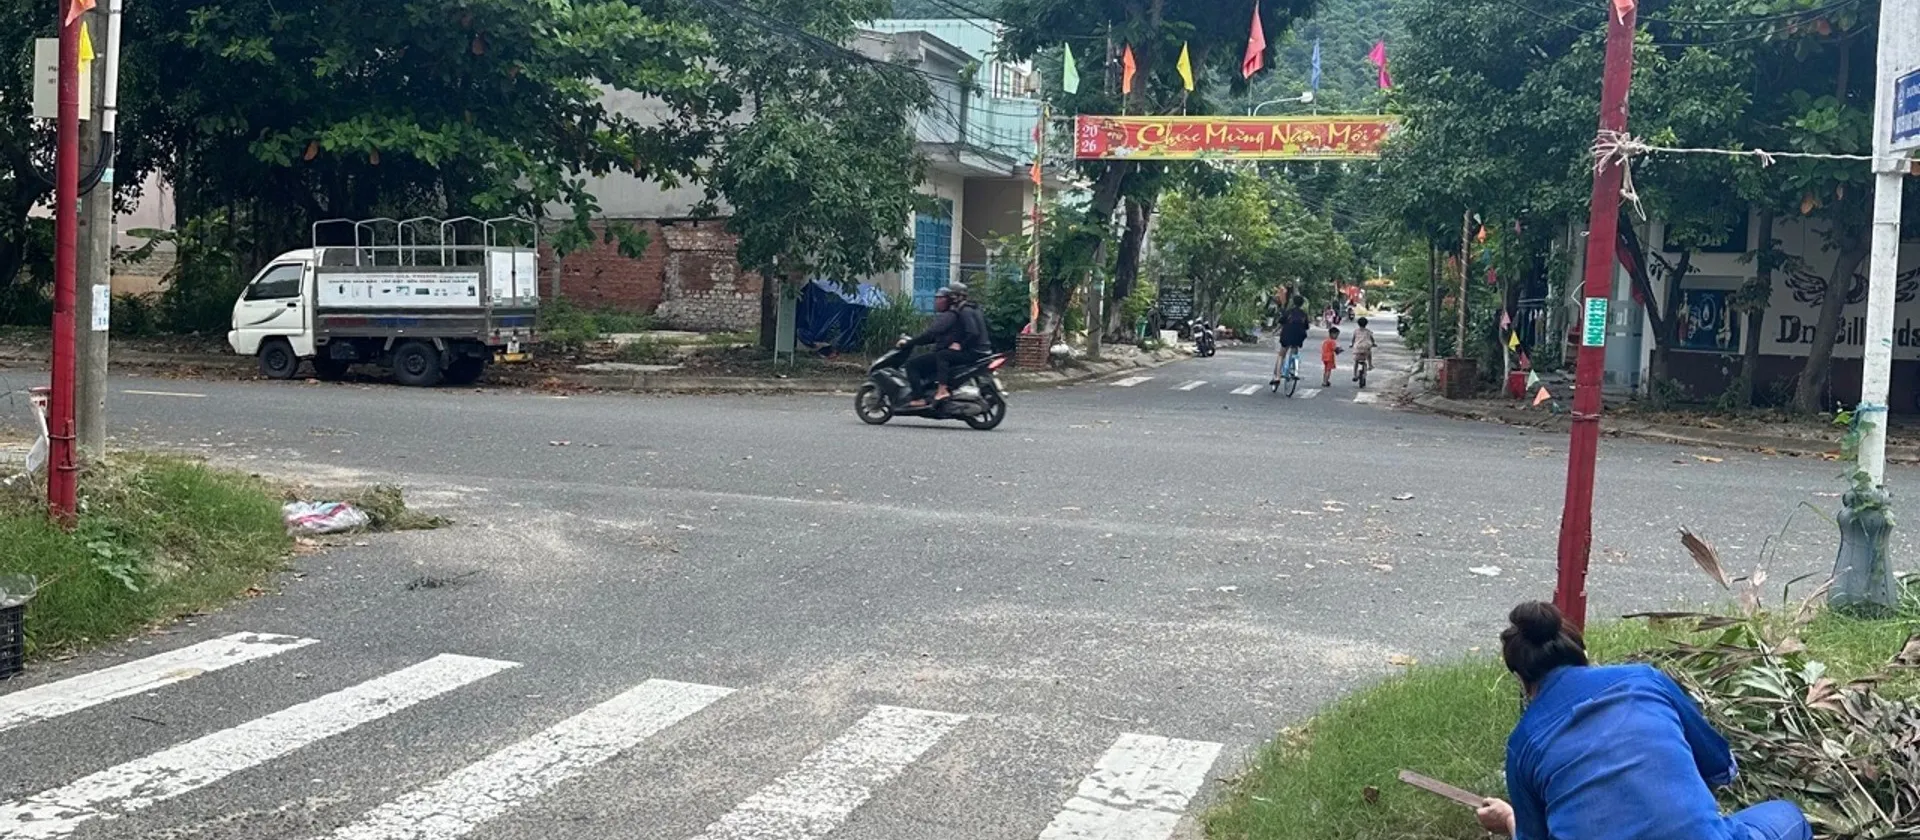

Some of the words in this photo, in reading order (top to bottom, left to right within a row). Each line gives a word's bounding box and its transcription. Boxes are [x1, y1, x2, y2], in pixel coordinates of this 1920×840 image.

[1082, 124, 1098, 138] 20
[1137, 119, 1201, 147] Chúc
[1205, 123, 1264, 157] Mừng
[1271, 123, 1322, 146] Năm
[1081, 139, 1097, 153] 26
